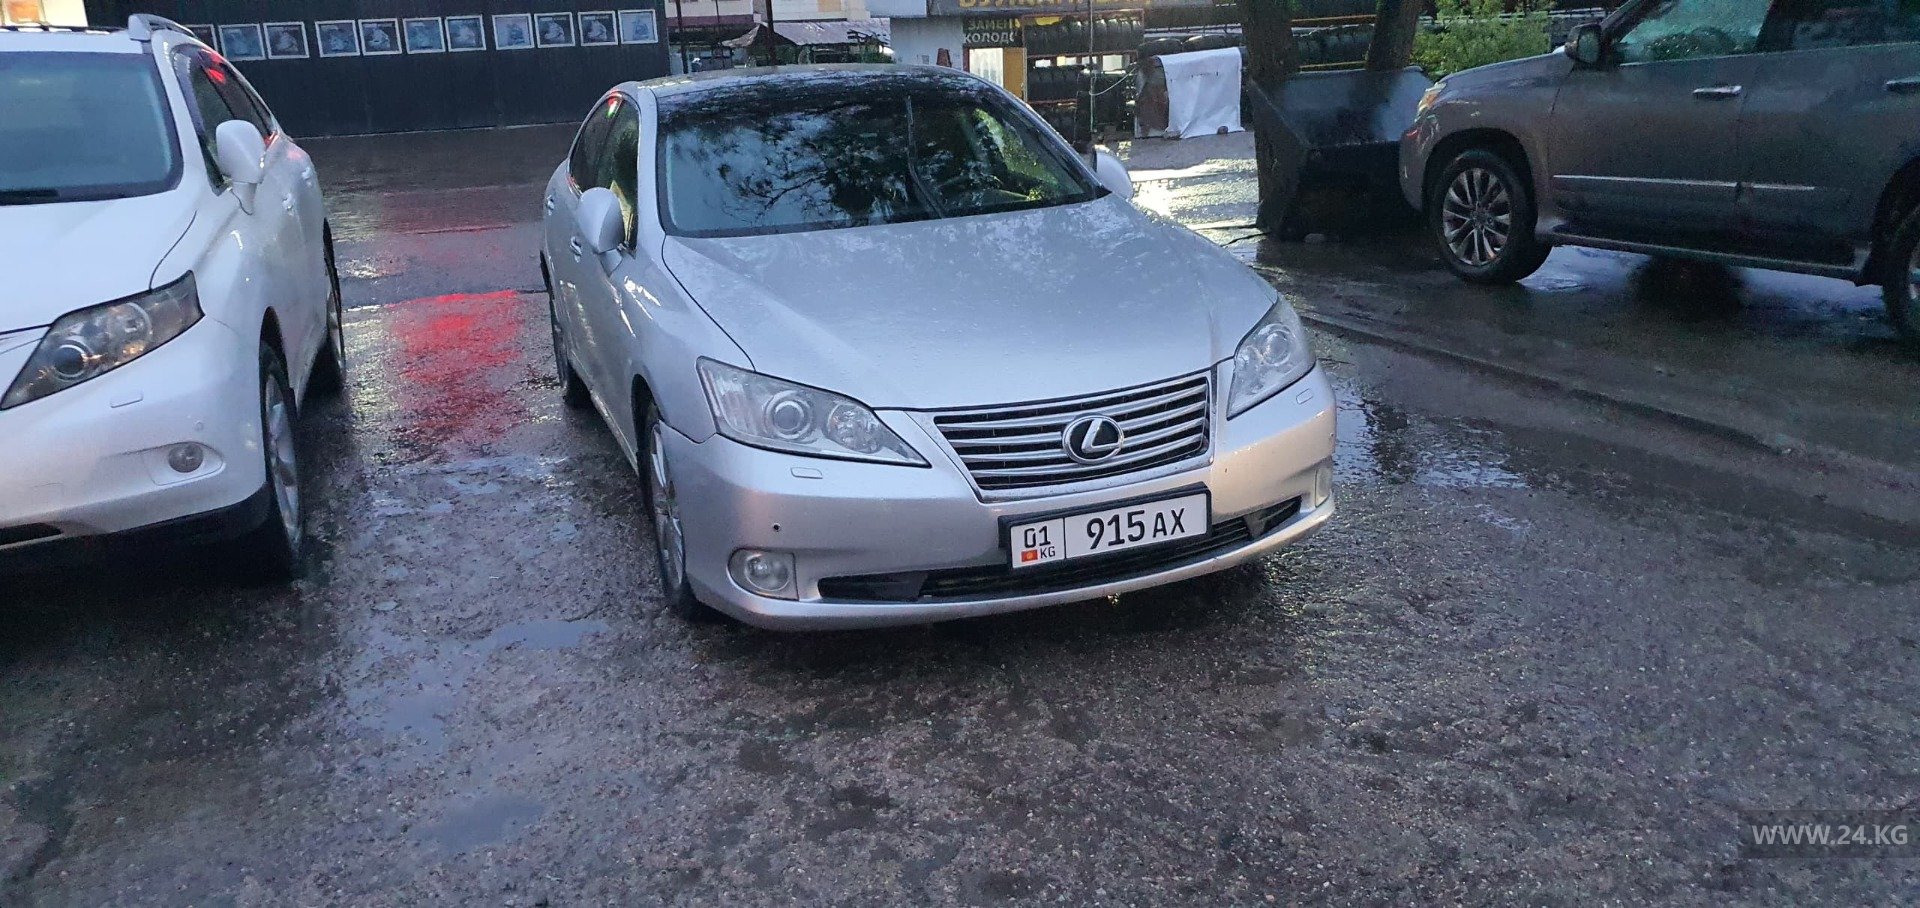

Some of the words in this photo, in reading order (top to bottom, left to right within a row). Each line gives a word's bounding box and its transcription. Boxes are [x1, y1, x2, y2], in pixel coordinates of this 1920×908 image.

[1024, 525, 1051, 549] 01
[1086, 509, 1146, 550] 915
[1152, 507, 1186, 539] AX
[1039, 546, 1056, 559] KG
